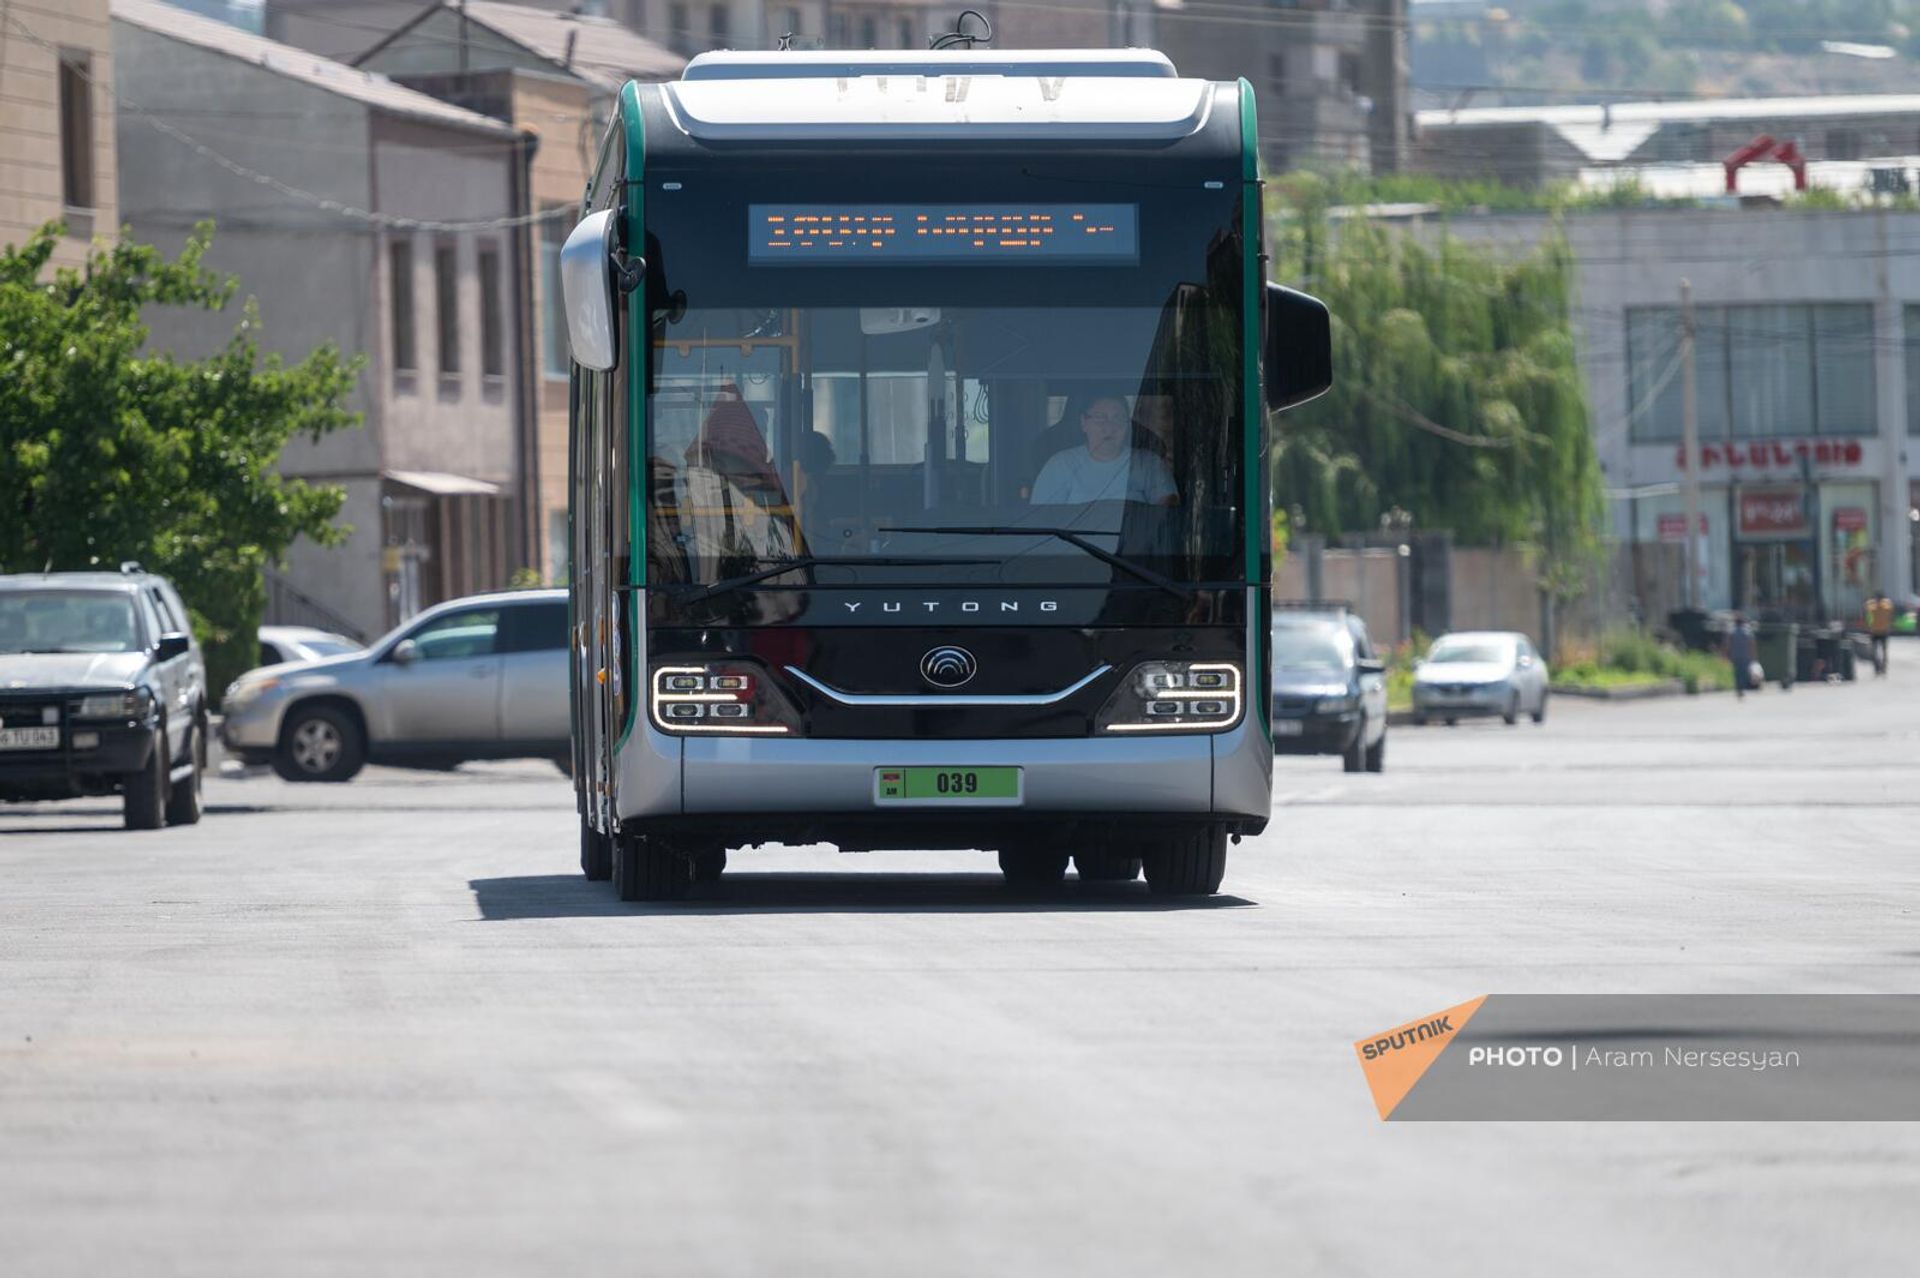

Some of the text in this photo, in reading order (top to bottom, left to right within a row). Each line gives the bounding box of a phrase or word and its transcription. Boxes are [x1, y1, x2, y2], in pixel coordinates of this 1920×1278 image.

[844, 601, 1058, 612] YUTONG
[937, 772, 977, 793] 039
[886, 786, 898, 795] AM
